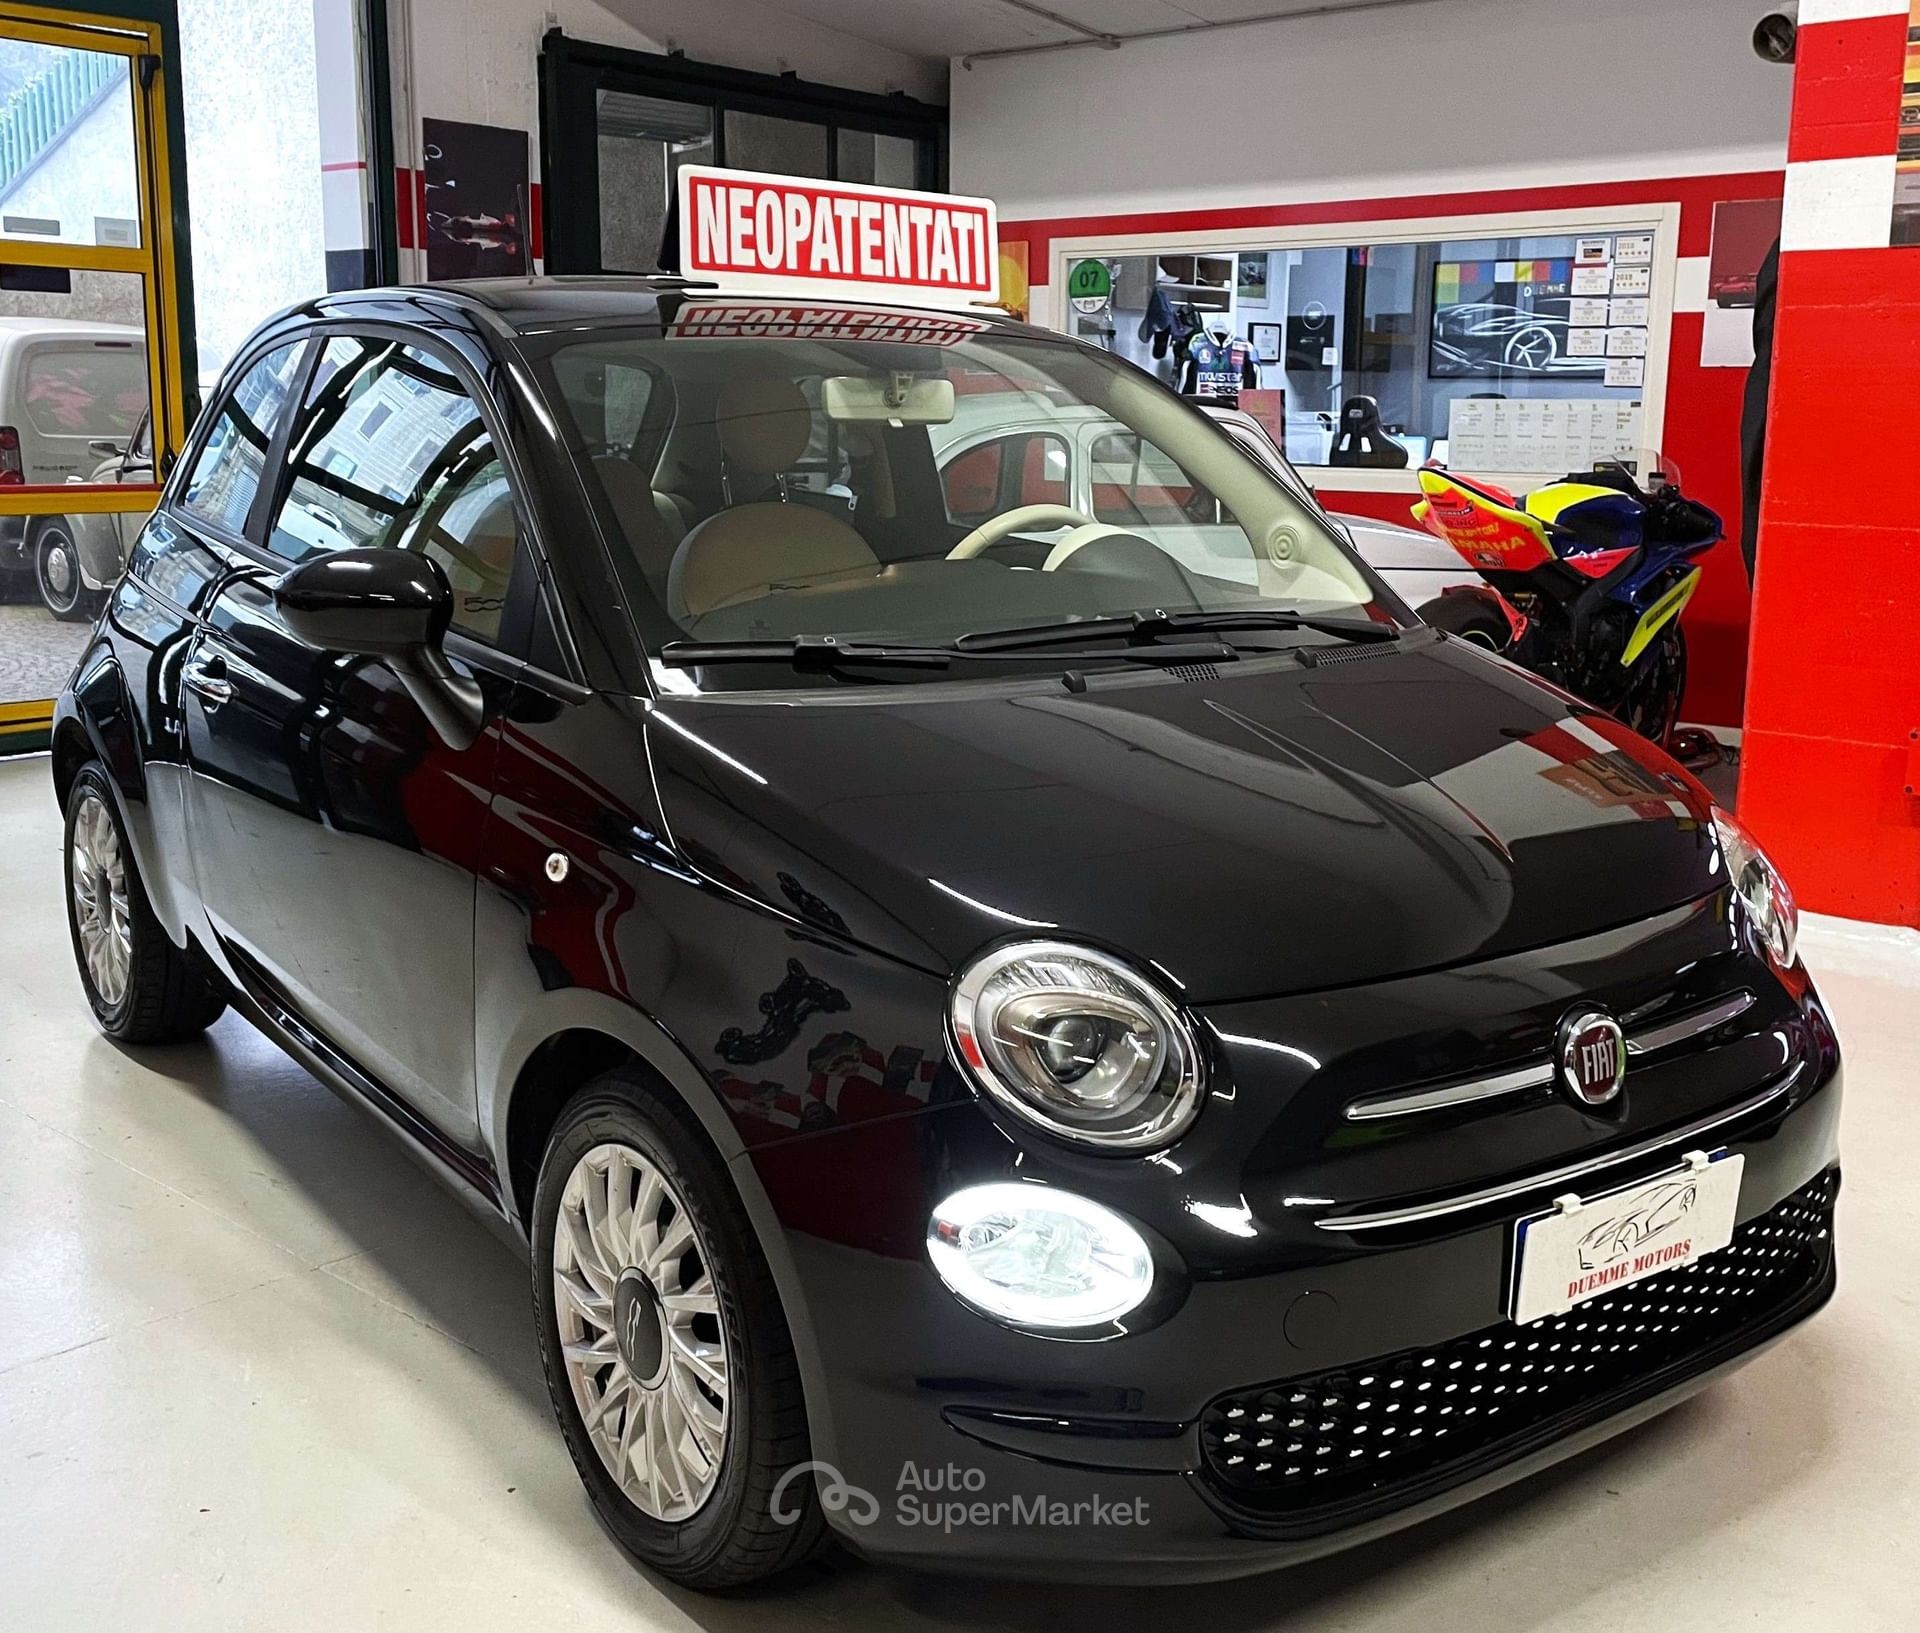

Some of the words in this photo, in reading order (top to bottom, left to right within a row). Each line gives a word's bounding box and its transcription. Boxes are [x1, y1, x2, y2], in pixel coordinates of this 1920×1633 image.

[696, 183, 987, 286] NEOPATENTATI
[1080, 271, 1099, 288] 07
[1581, 1037, 1617, 1085] FIAT
[1567, 1261, 1630, 1299] DUEMME
[1632, 1238, 1693, 1273] MOTORS
